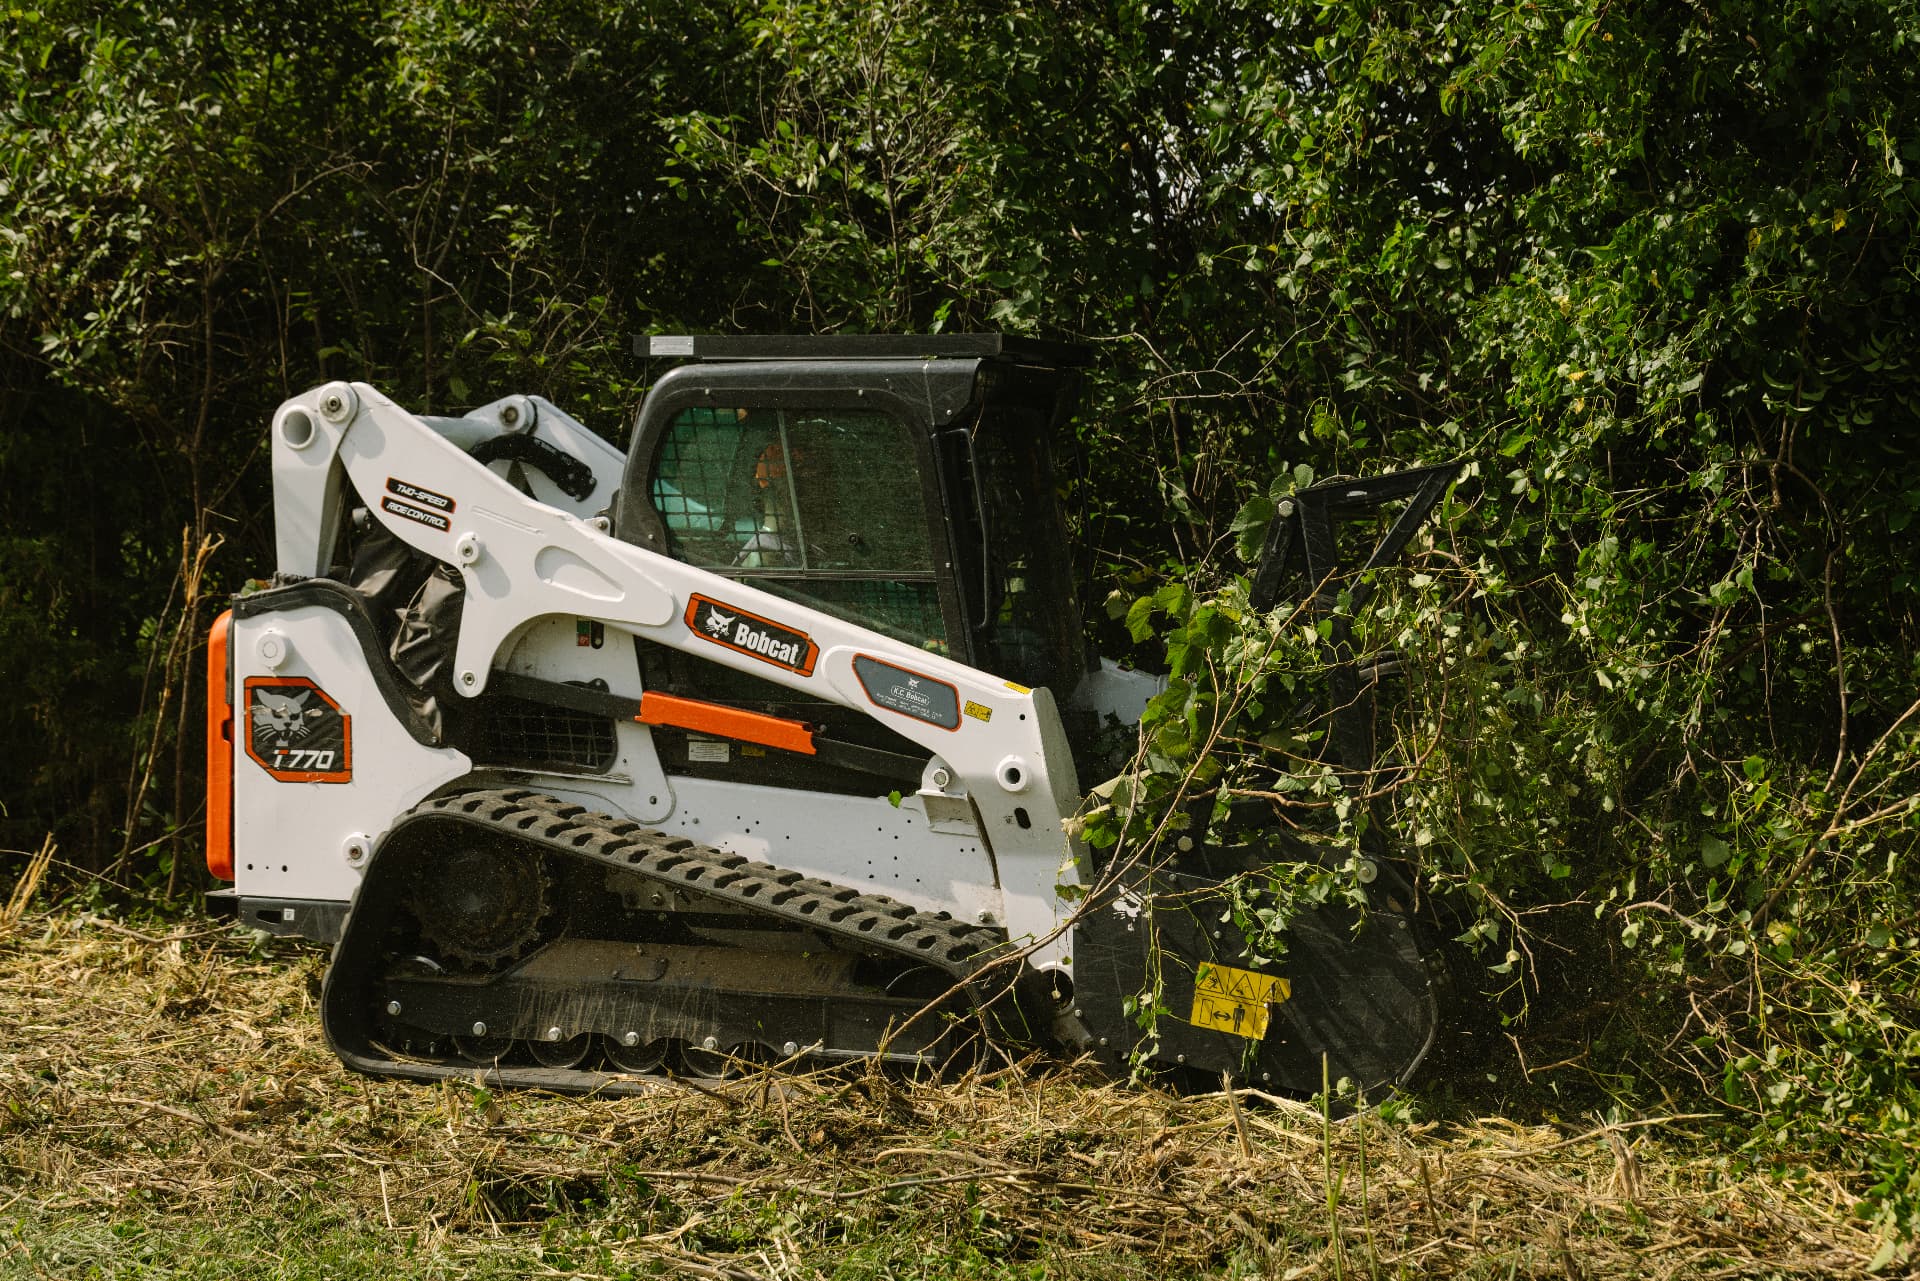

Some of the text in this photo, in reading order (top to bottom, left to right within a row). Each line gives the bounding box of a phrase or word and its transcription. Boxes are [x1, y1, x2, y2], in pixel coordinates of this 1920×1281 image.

[397, 484, 448, 507] TWO-SPEED
[386, 502, 446, 528] RIDE CONTROL
[734, 622, 799, 665] Bobcat
[905, 691, 928, 704] Bobcat
[273, 749, 335, 769] T770
